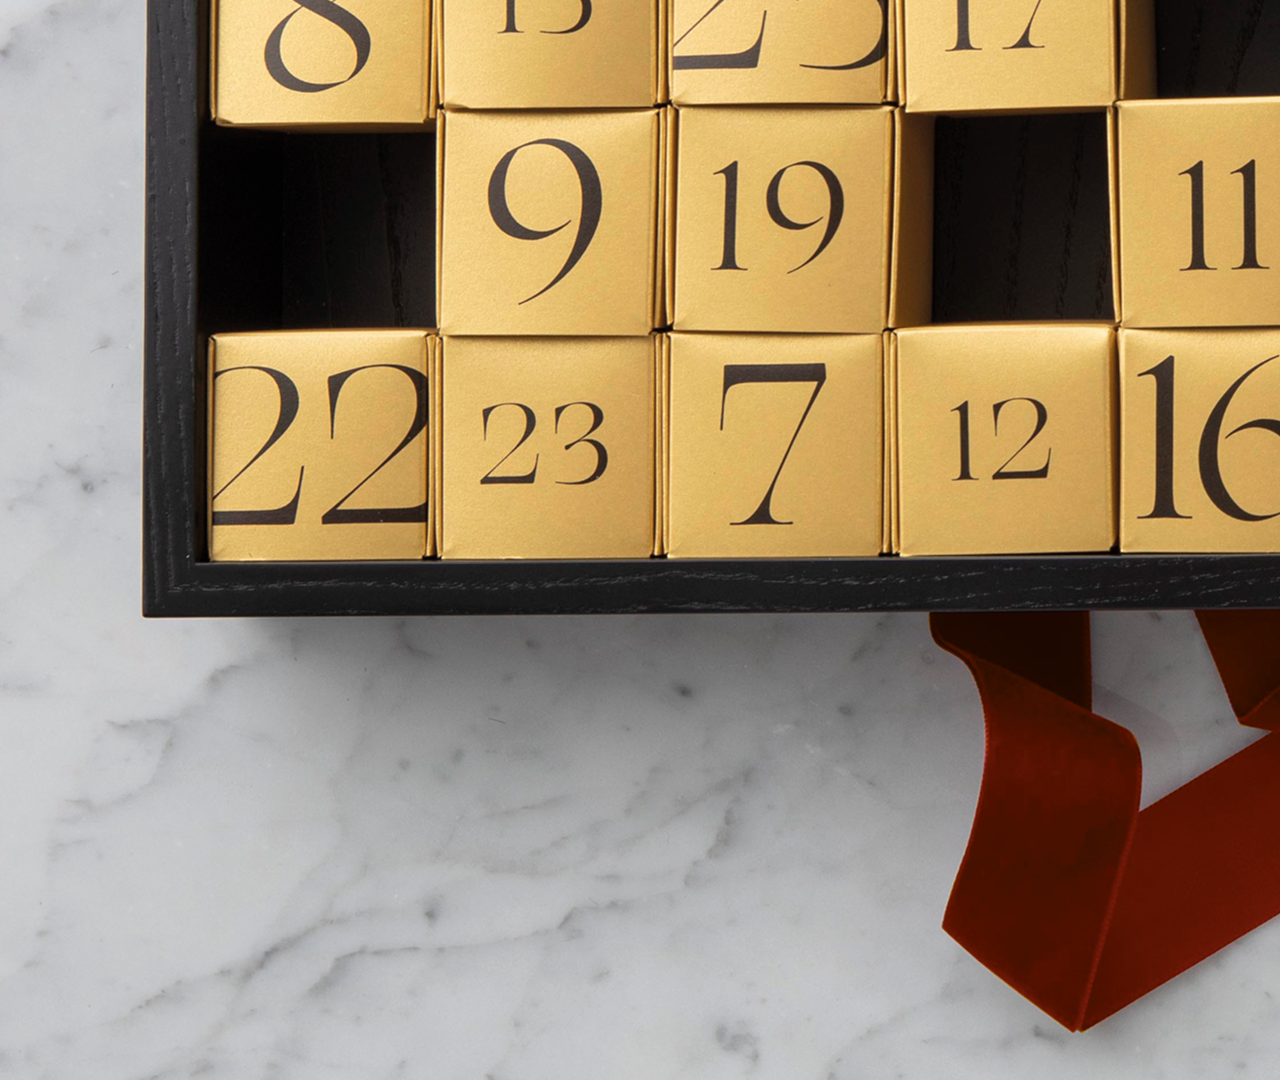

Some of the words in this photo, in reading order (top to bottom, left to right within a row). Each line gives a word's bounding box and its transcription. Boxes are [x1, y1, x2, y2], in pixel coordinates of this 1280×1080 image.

[488, 139, 602, 305] 9
[711, 161, 844, 274] 19
[1179, 159, 1269, 271] 11
[213, 364, 428, 524] 22
[481, 401, 609, 485] 23
[720, 363, 826, 525] 7
[951, 398, 1051, 480] 12
